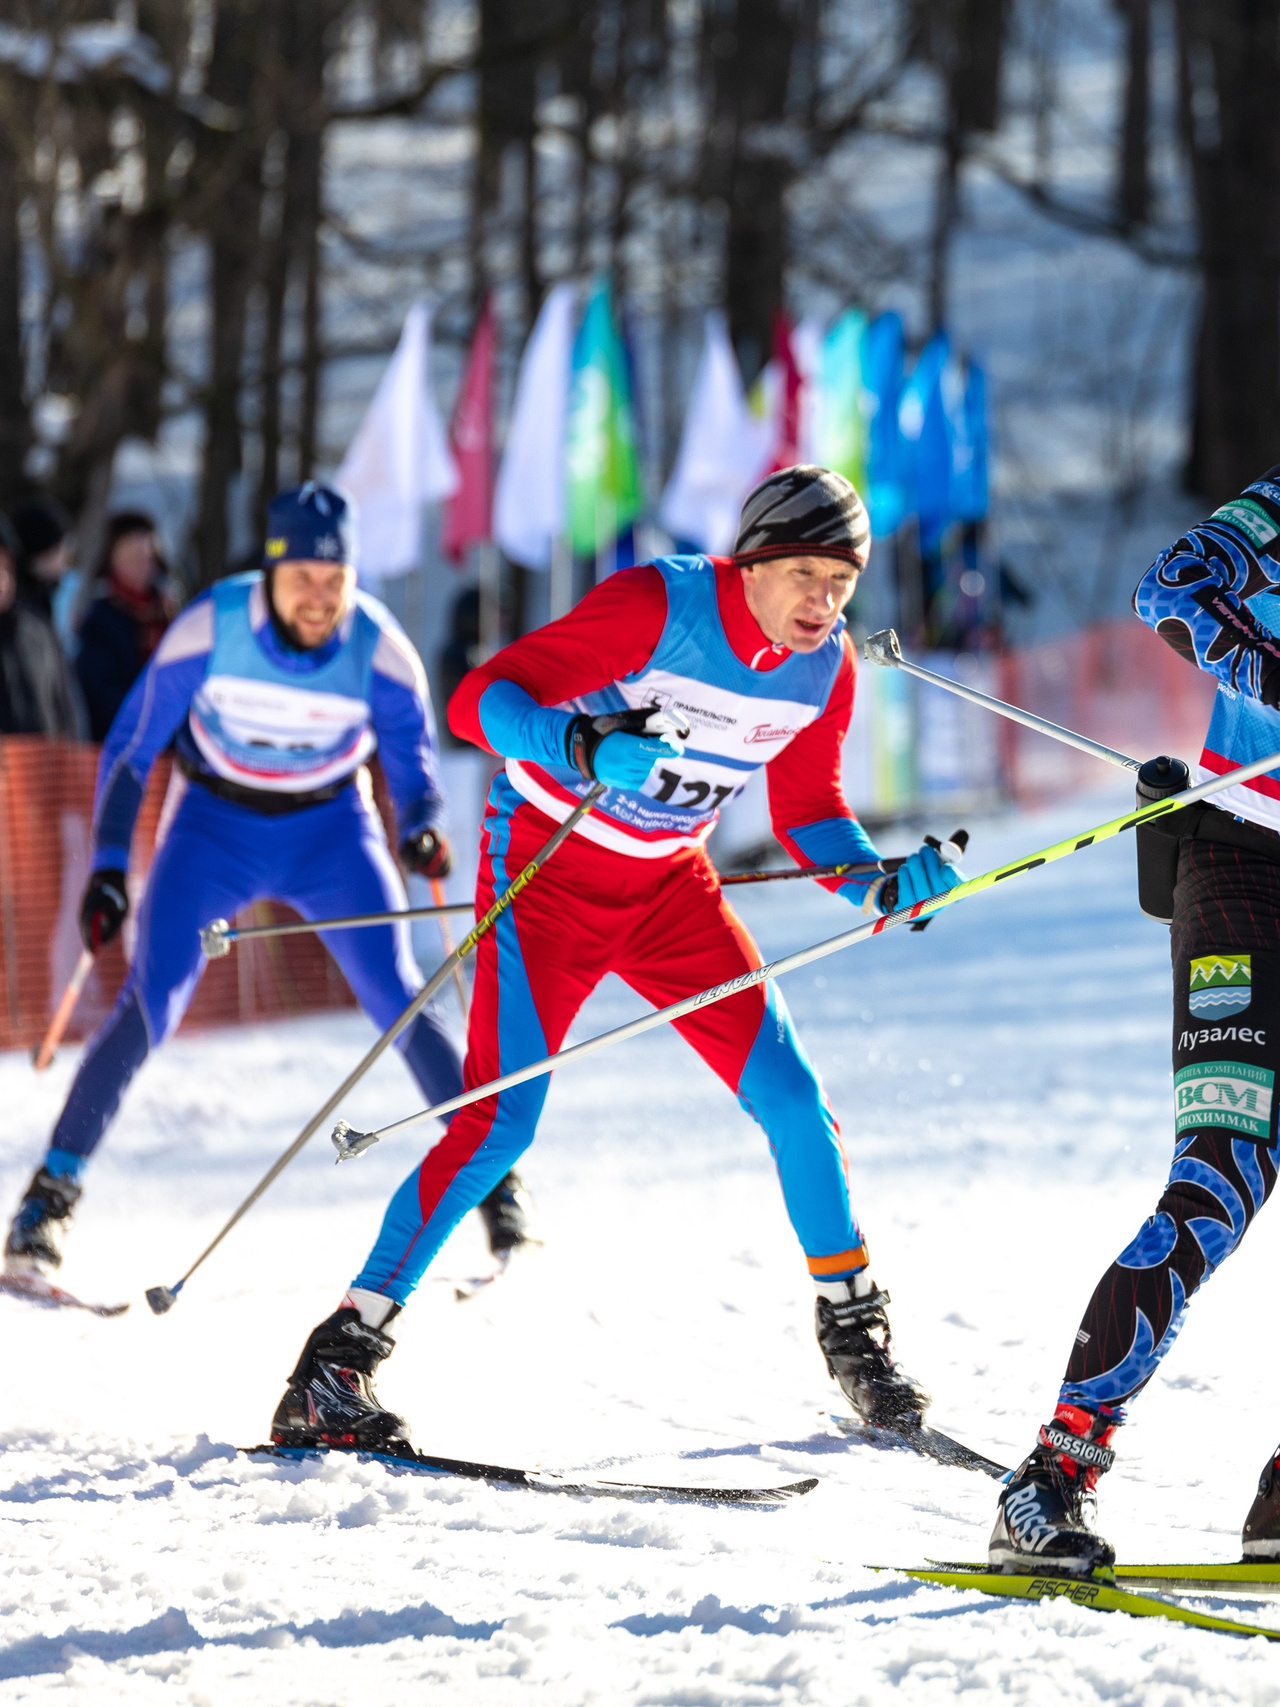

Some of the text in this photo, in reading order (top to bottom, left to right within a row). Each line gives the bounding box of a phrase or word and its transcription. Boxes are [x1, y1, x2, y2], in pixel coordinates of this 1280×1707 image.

[1178, 1026, 1266, 1051] Лузалес
[1203, 1064, 1268, 1083] КОМПАНИЙ
[1025, 1578, 1101, 1603] FISCHER
